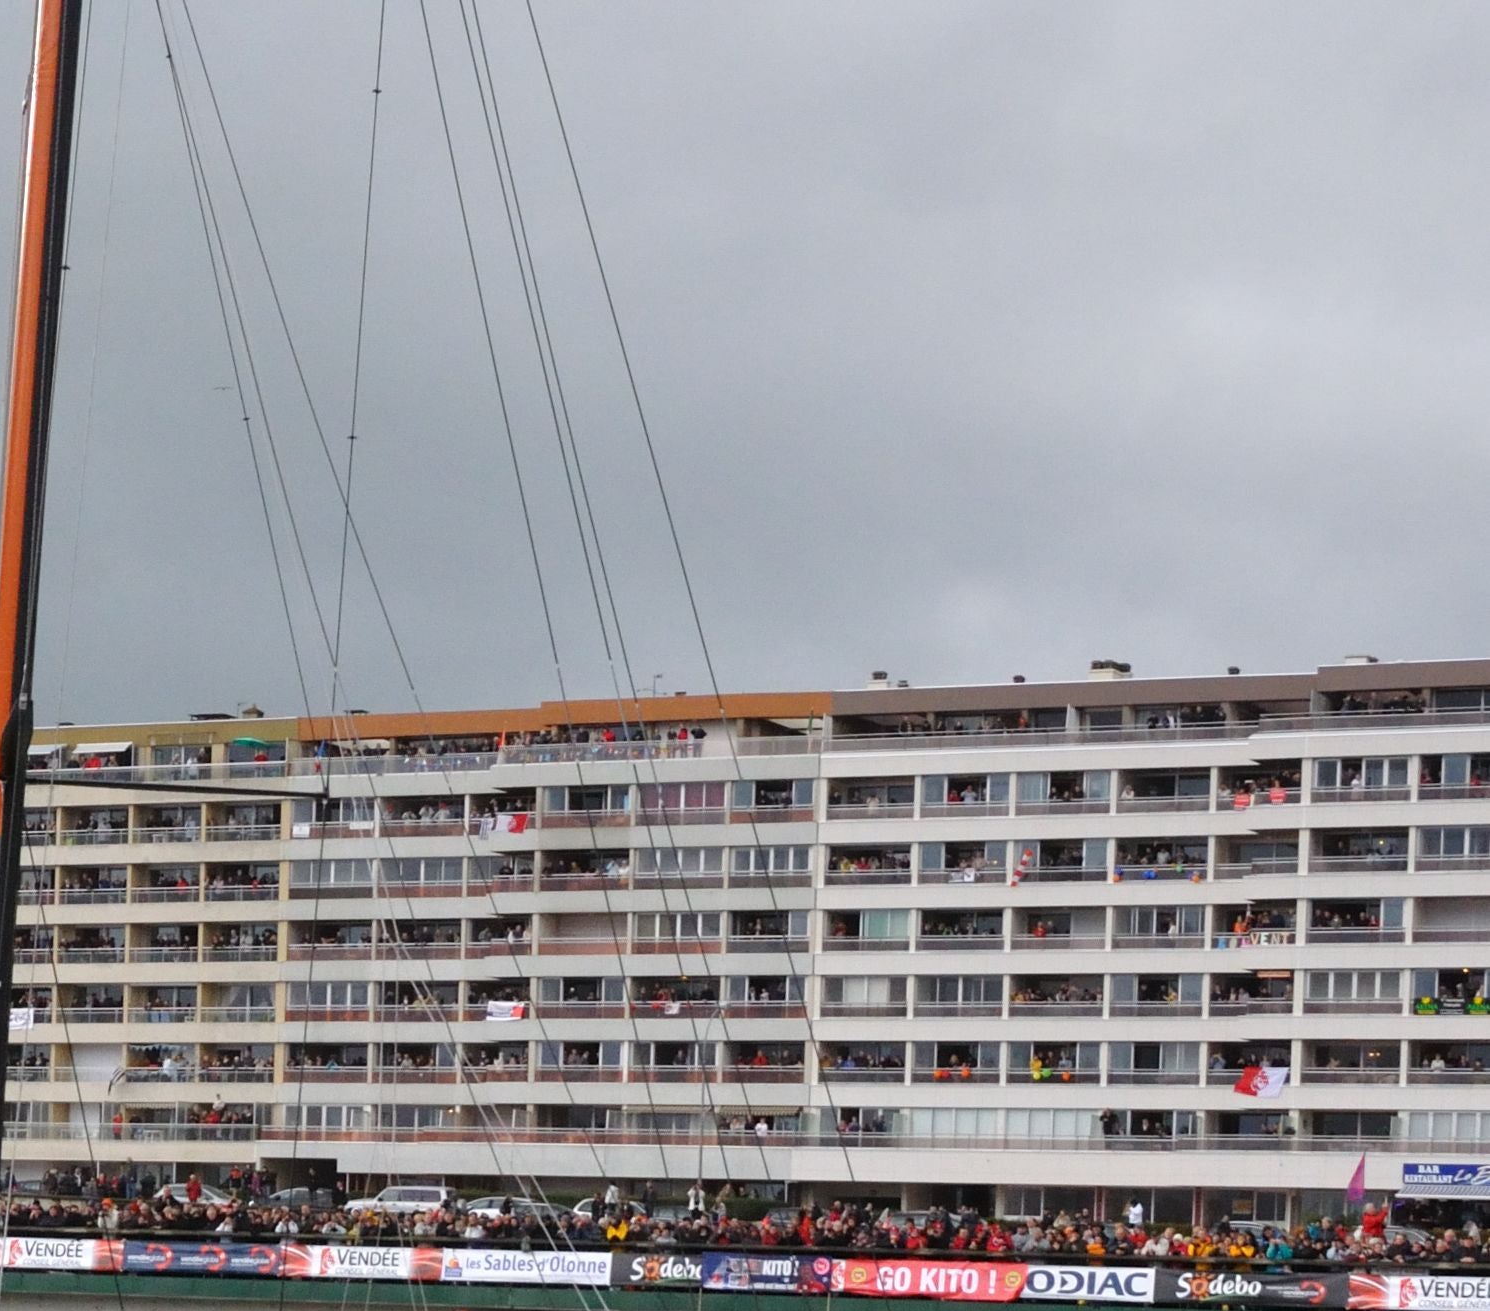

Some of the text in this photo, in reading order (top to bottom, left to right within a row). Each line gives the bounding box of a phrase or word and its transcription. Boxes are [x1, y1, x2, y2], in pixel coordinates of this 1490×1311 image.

[1404, 1174, 1453, 1184] RESTAURANT
[1418, 1164, 1440, 1174] BAR
[25, 1239, 84, 1258] VENDÉE
[336, 1247, 399, 1267] VENDÉE
[466, 1255, 607, 1275] les Sables d'Olonne
[762, 1260, 792, 1276] KITO
[875, 1266, 996, 1295] GO KITO !
[1026, 1269, 1149, 1297] ODIAC
[1175, 1273, 1262, 1299] Sodebo
[1420, 1276, 1490, 1299] VENDÉ
